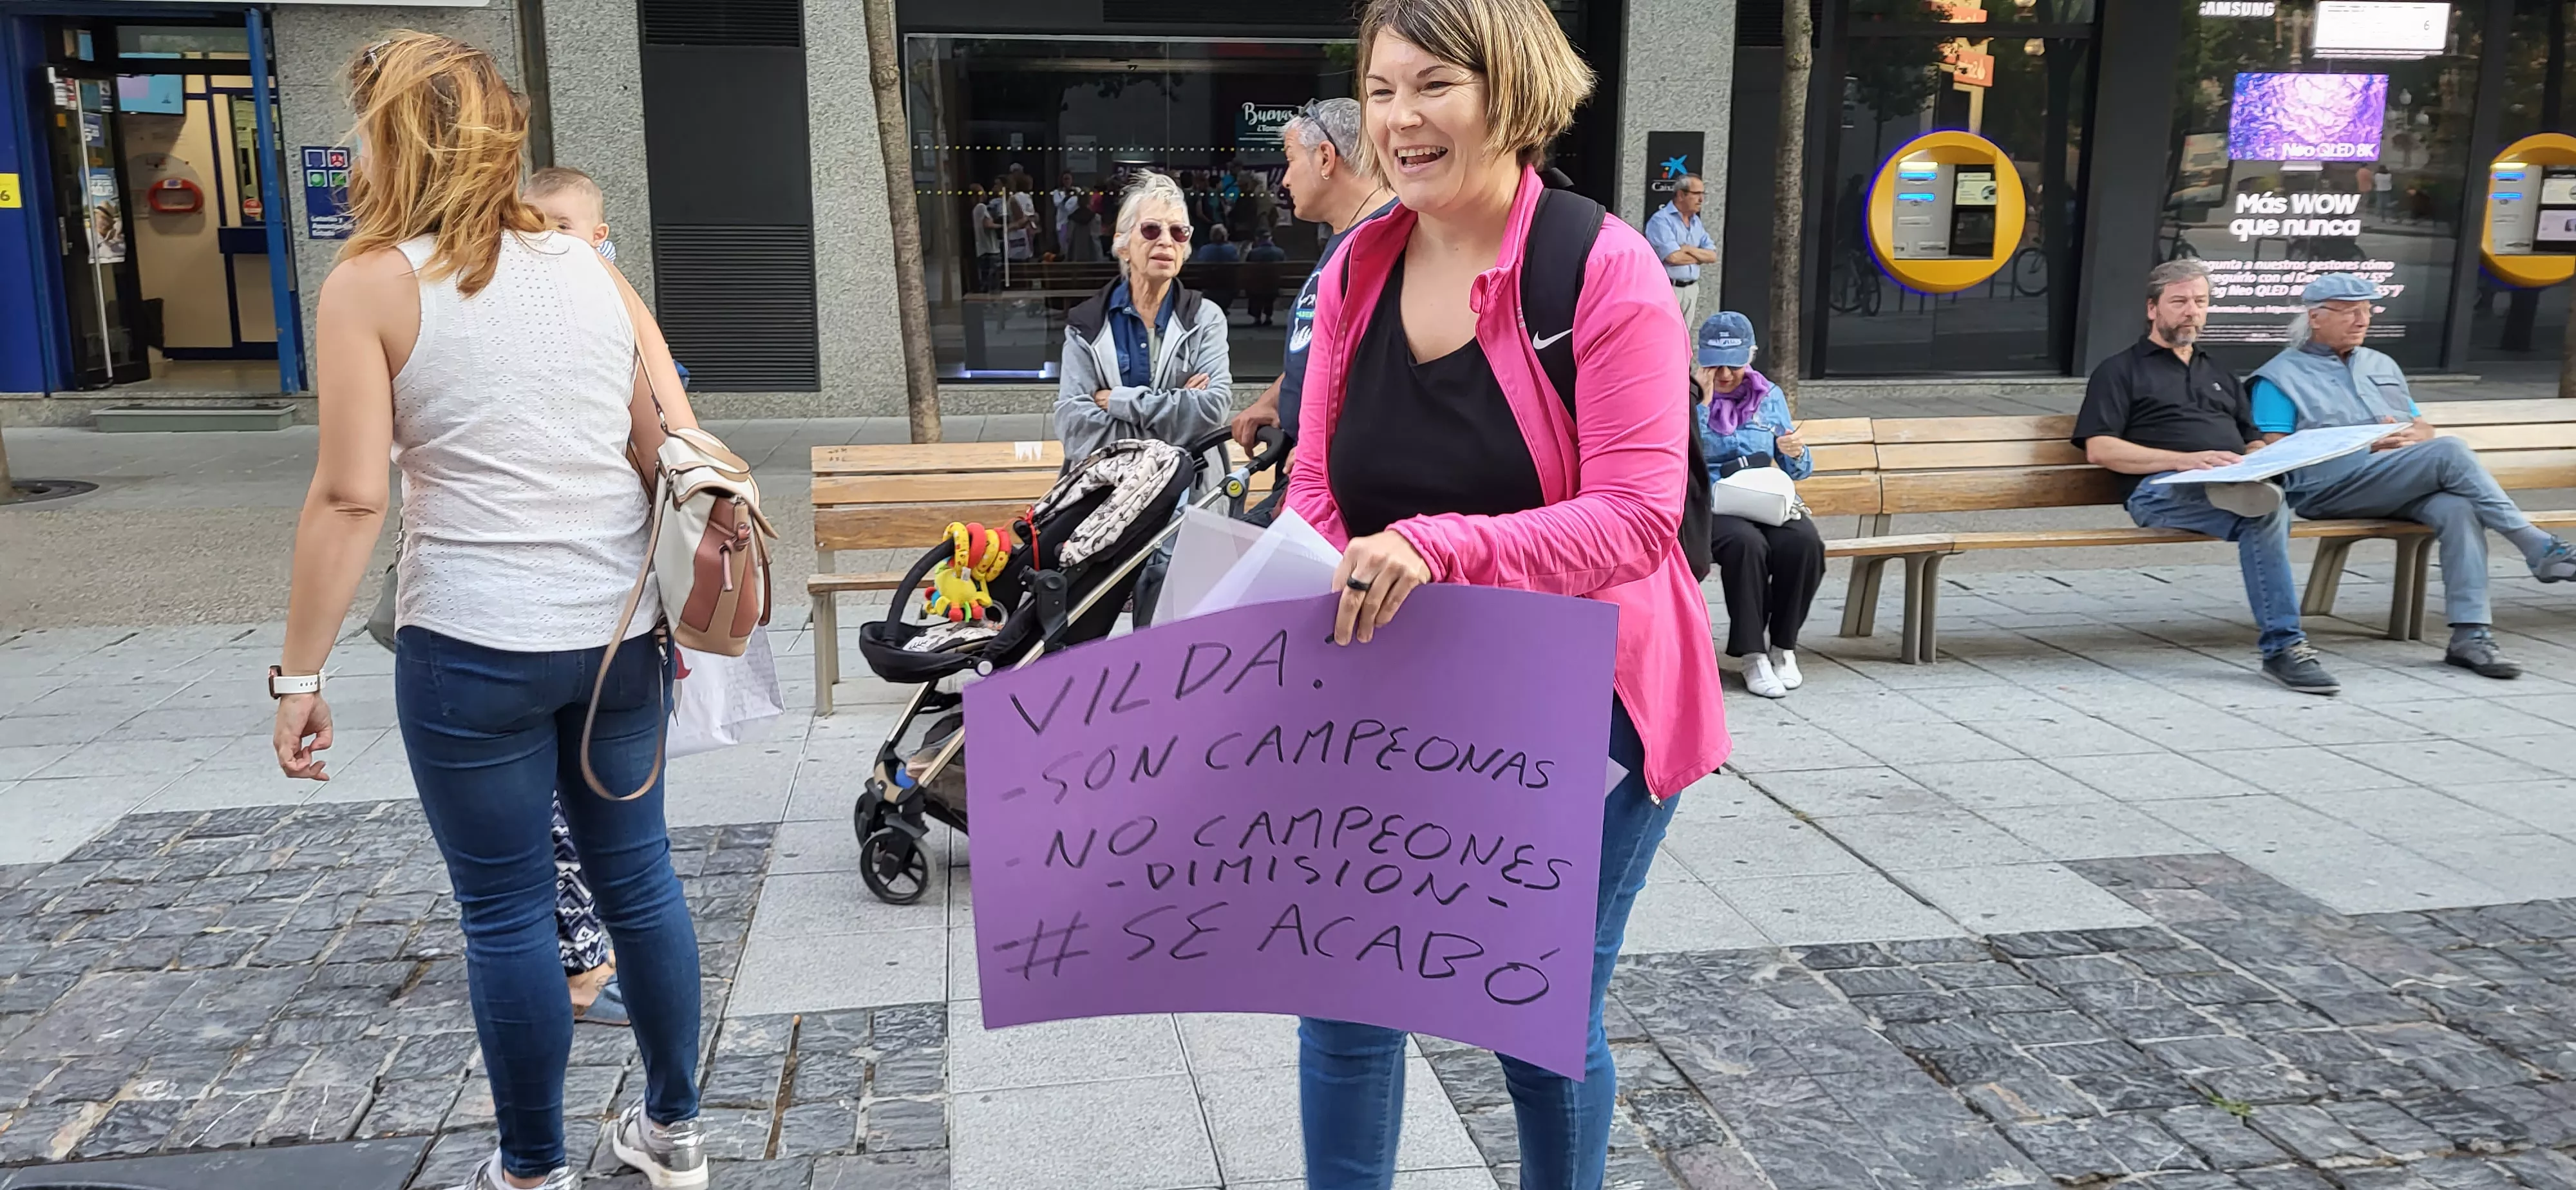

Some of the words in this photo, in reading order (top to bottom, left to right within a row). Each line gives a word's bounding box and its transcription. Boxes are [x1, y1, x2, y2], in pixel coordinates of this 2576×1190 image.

[1241, 102, 1294, 126] Buenas
[2282, 142, 2315, 156] Neo
[2317, 143, 2355, 157] QLED
[2356, 143, 2376, 157] 8K
[2235, 191, 2288, 214] Más
[2289, 193, 2362, 214] WOW
[2230, 218, 2280, 242] que
[2281, 218, 2362, 236] nunca
[2242, 261, 2253, 270] a
[2255, 260, 2307, 270] nuestros
[2307, 260, 2360, 272] gestores
[2360, 259, 2395, 270] cómo
[2255, 285, 2289, 297] QLED
[1205, 719, 1555, 789] CAMPEONAS
[1193, 806, 1573, 891] CAMPEONES
[1257, 903, 1561, 1005] ACABÓ
